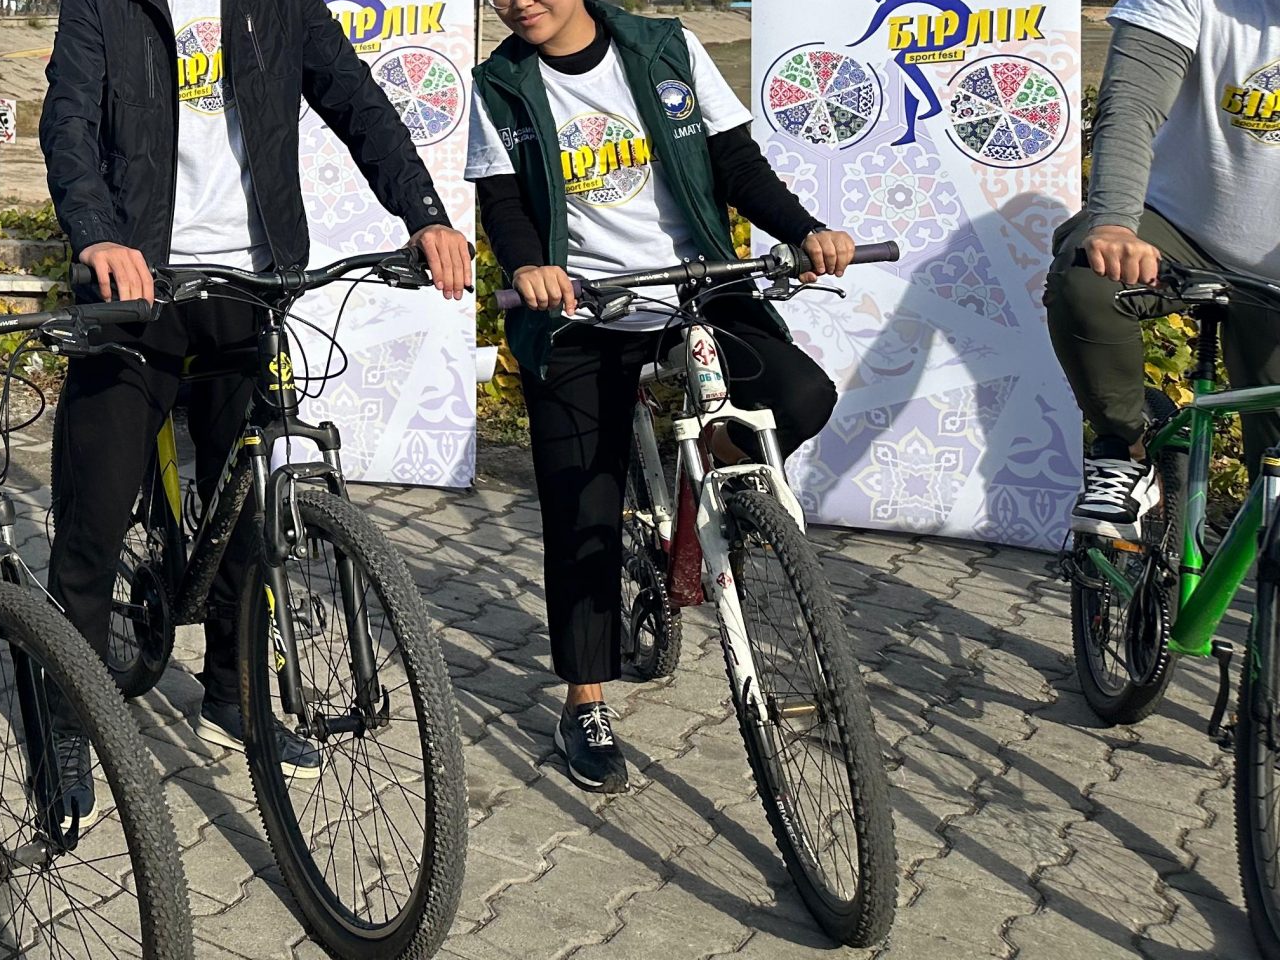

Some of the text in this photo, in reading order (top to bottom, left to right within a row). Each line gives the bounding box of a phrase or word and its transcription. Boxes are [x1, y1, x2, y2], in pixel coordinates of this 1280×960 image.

[332, 1, 446, 40] ІРЛІК
[887, 4, 1047, 50] БІРЛІК
[909, 50, 958, 63] sport fest
[194, 86, 209, 96] fest
[560, 136, 659, 181] ІРЛІК
[565, 179, 600, 194] port fest
